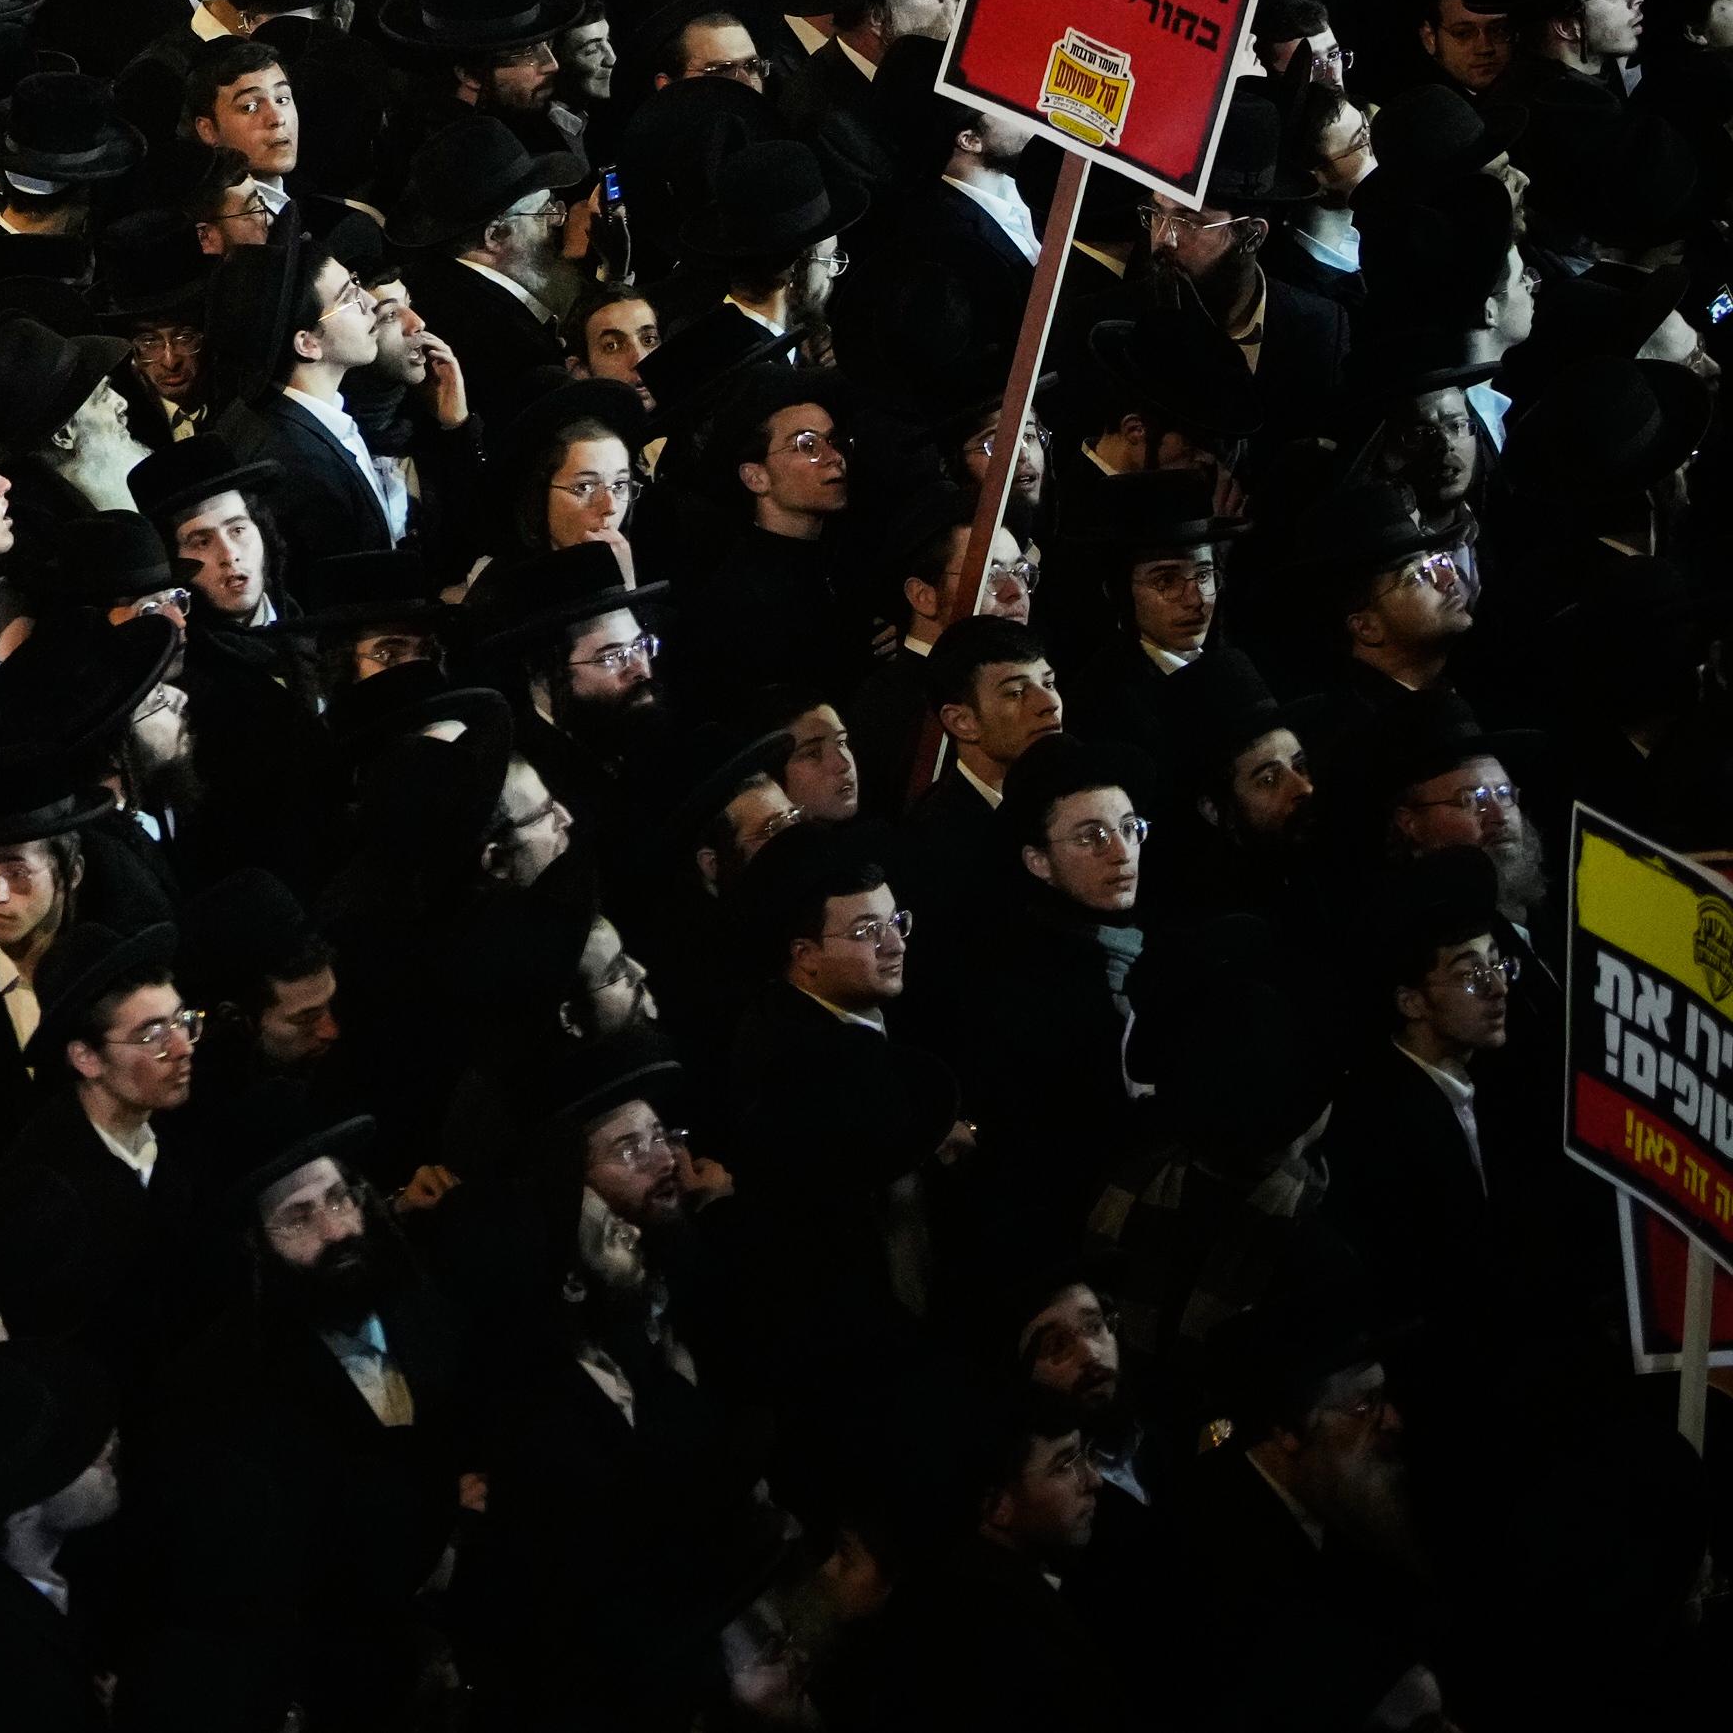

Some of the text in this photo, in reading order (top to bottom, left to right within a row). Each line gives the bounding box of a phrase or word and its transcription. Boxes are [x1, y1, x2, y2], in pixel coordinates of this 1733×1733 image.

[1054, 59, 1098, 99] שוועתם
[1099, 56, 1119, 75] מעמד
[1097, 76, 1119, 114] קול
[1594, 948, 1673, 1044] את
[1625, 1107, 1678, 1177] כאן!
[1684, 1153, 1710, 1204] זה
